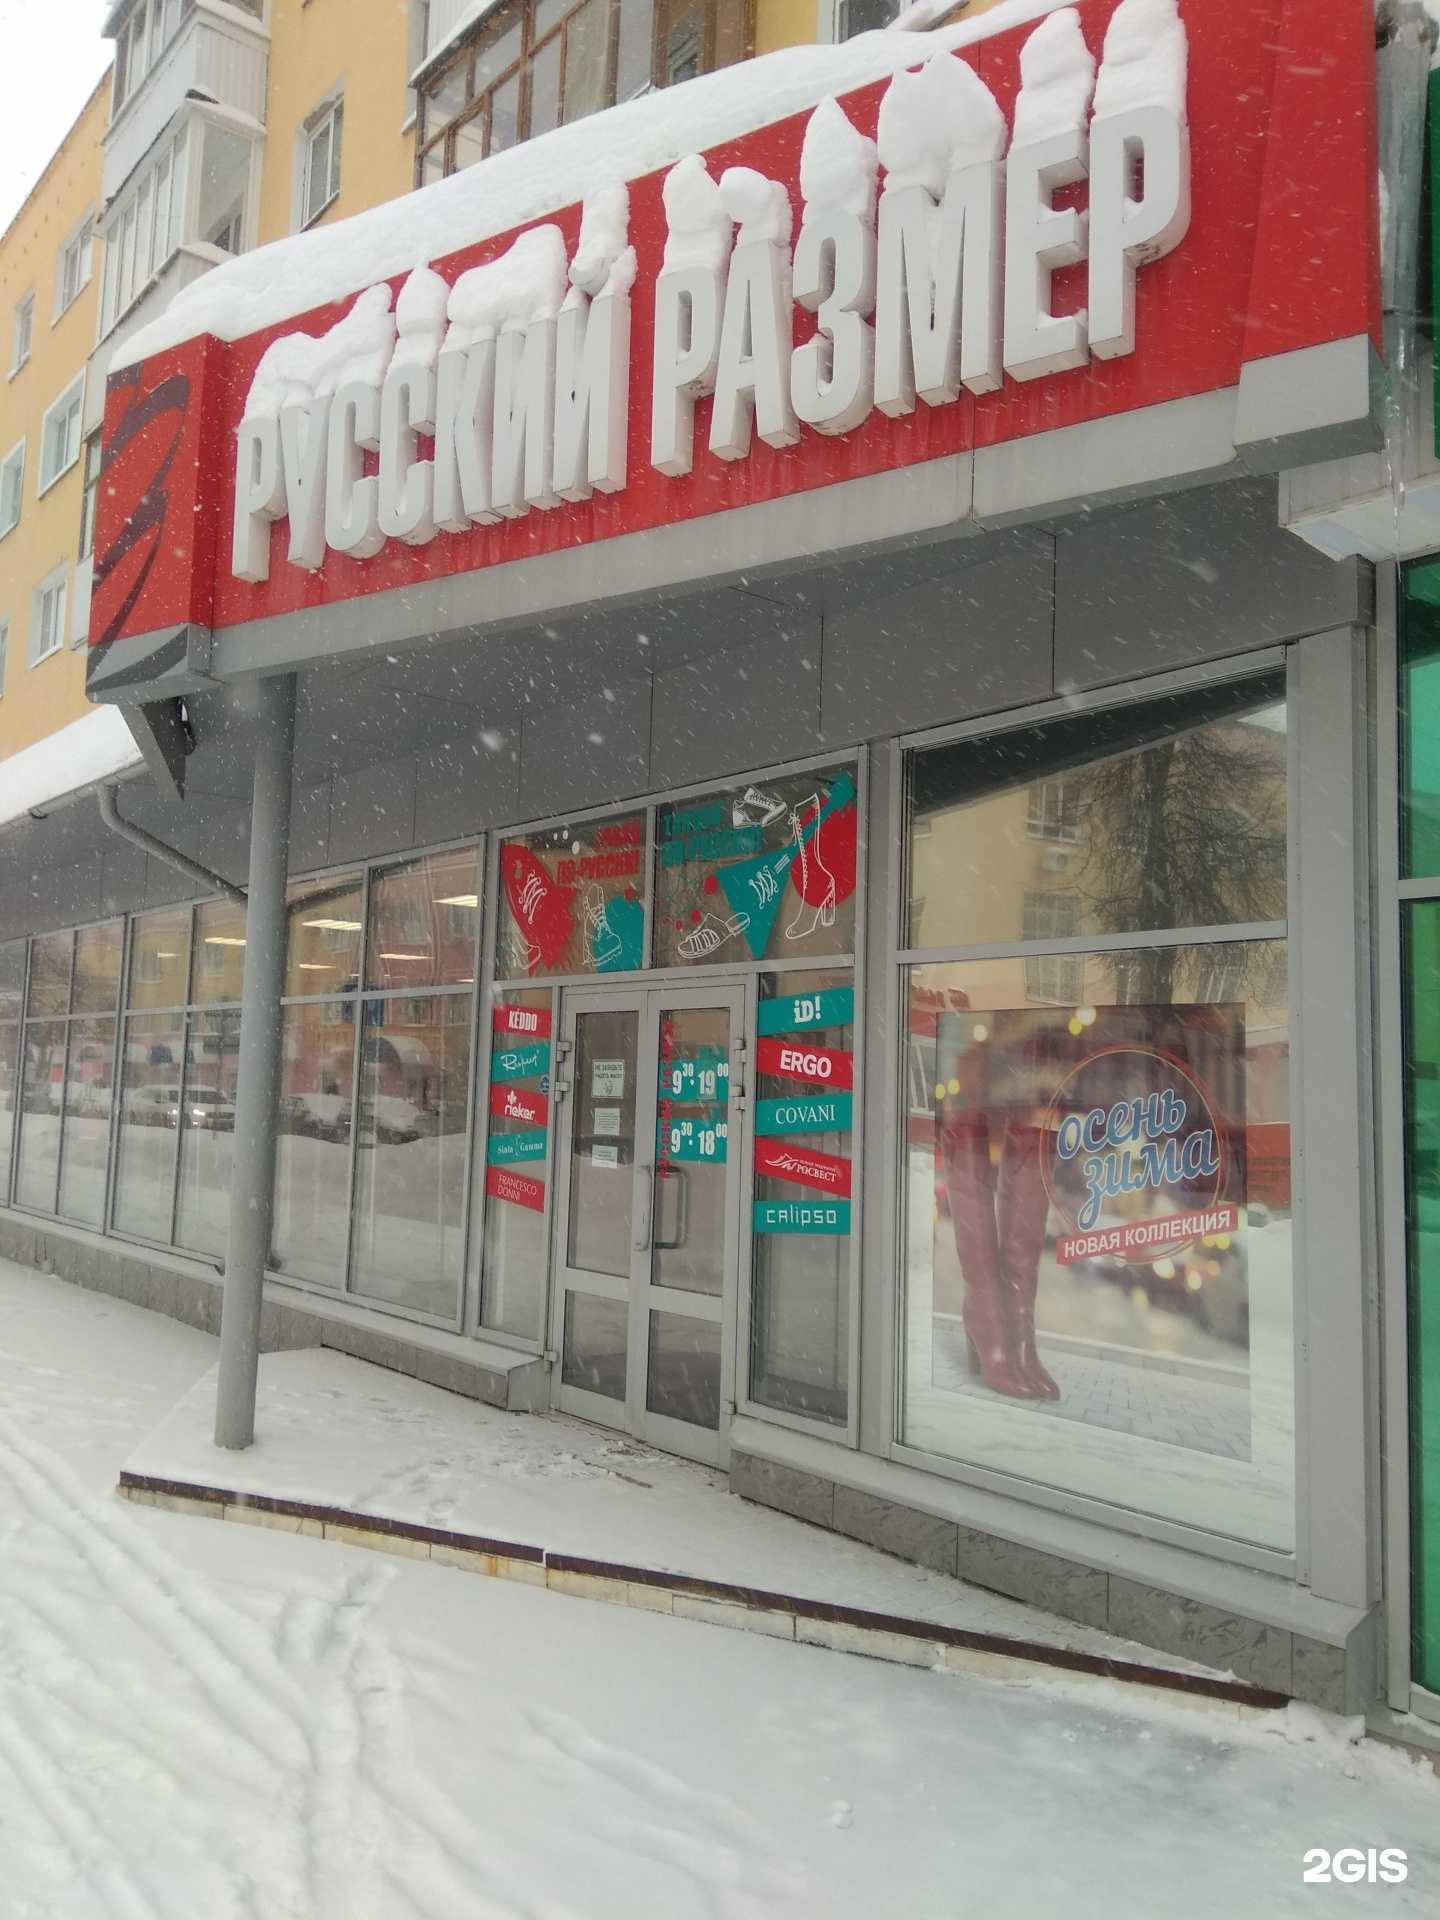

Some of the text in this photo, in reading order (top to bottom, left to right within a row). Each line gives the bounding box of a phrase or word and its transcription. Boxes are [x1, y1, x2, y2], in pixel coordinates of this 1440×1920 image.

[232, 106, 1191, 582] РУССКИЙ РАЗМЕР
[780, 1049, 832, 1078] ERGO
[504, 1104, 535, 1121] rieker
[775, 1104, 835, 1125] COVANI
[1056, 1088, 1187, 1160] осень
[497, 1184, 520, 1201] DONNI
[499, 1174, 537, 1196] FRANCESCO
[1078, 1129, 1220, 1231] зима
[1064, 1210, 1231, 1259] НОВАЯ КОЛЛЕКЦИЯ
